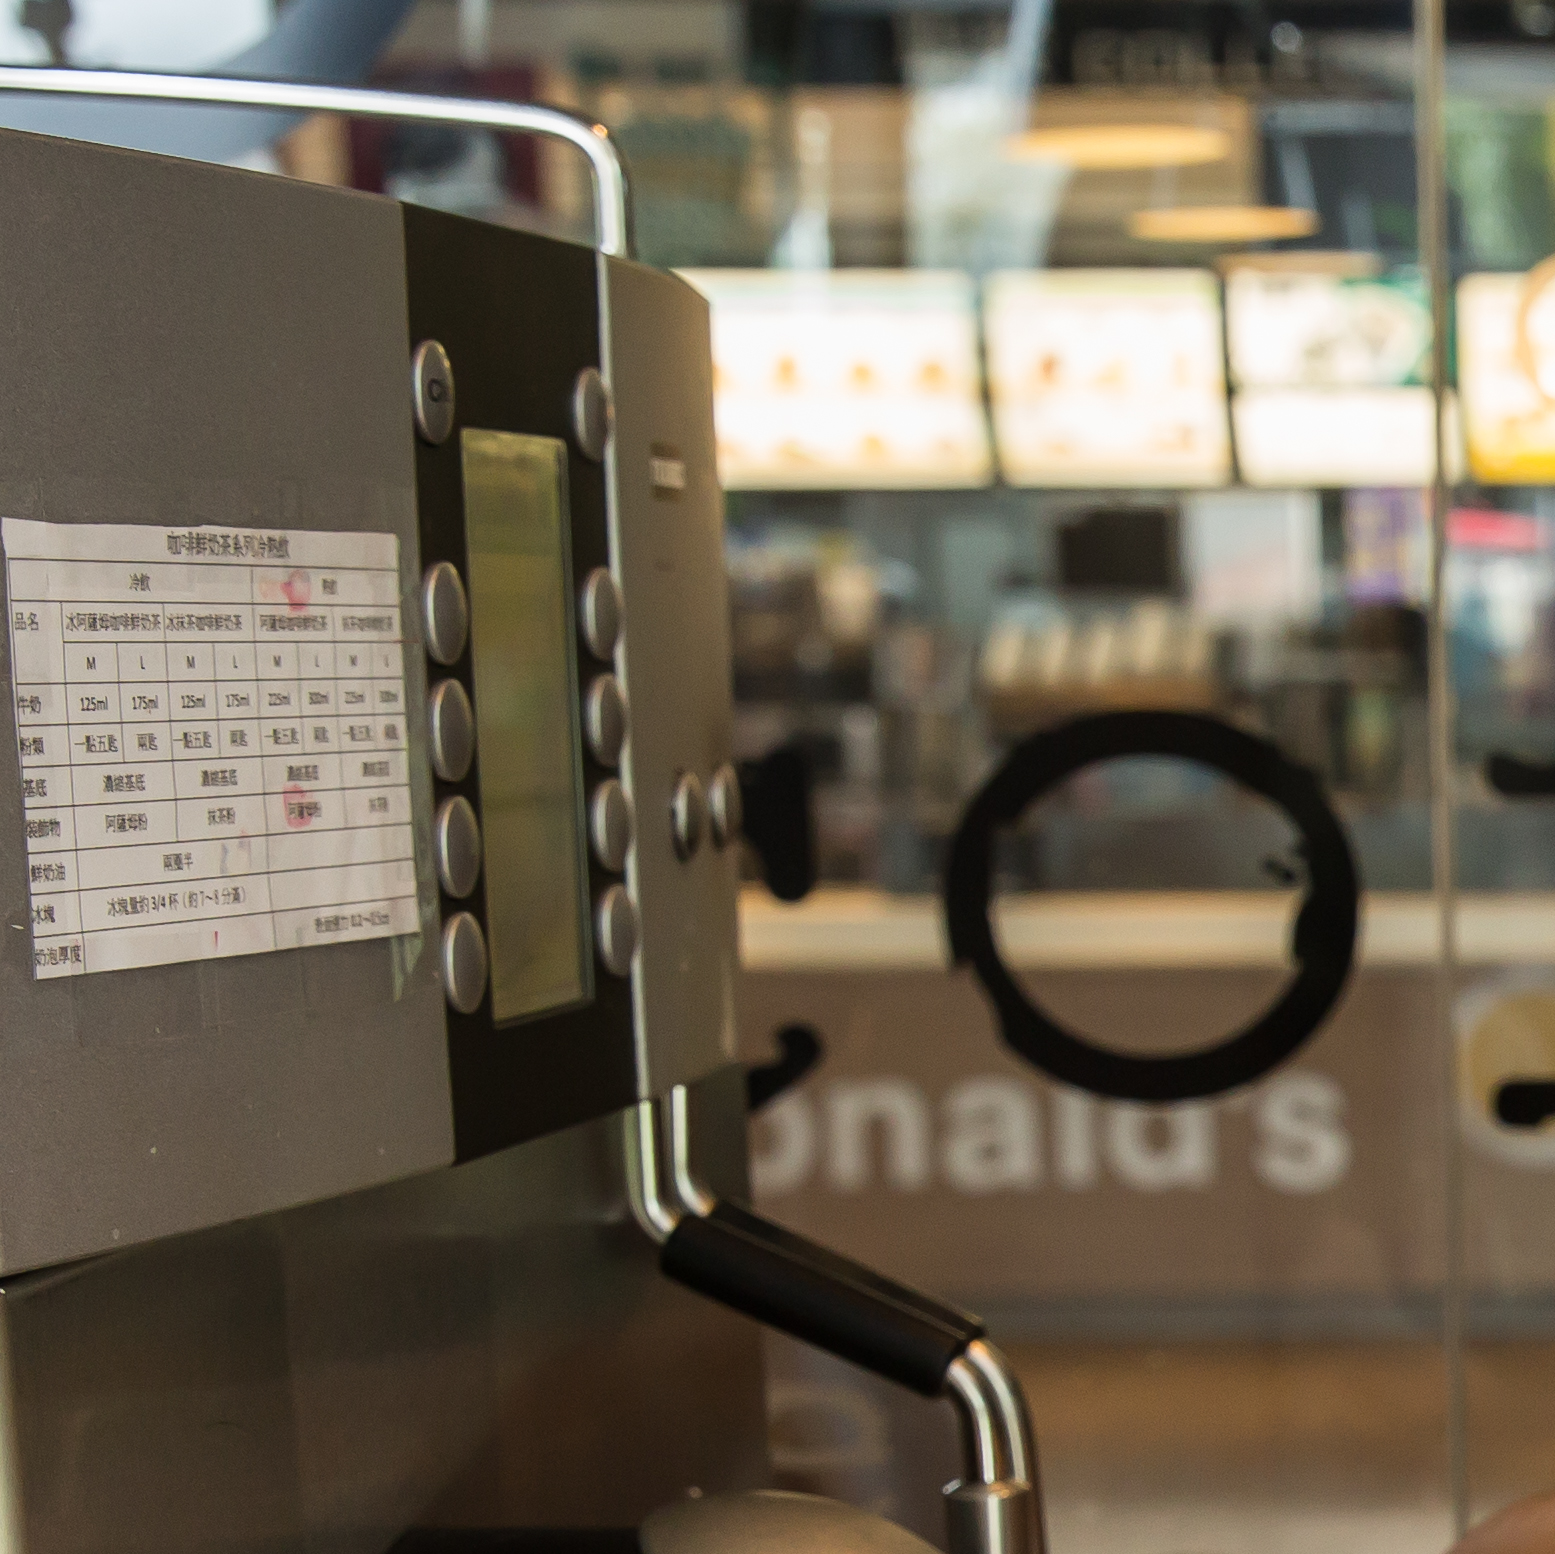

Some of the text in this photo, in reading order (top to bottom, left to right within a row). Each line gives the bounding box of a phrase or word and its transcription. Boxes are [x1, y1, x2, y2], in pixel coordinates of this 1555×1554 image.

[14, 611, 39, 632] 品名
[17, 695, 42, 715] 牛奶
[80, 695, 109, 712] 125ml
[132, 695, 159, 711] 175ml
[181, 693, 206, 709] 125ml
[30, 862, 67, 884] 鮮奶油
